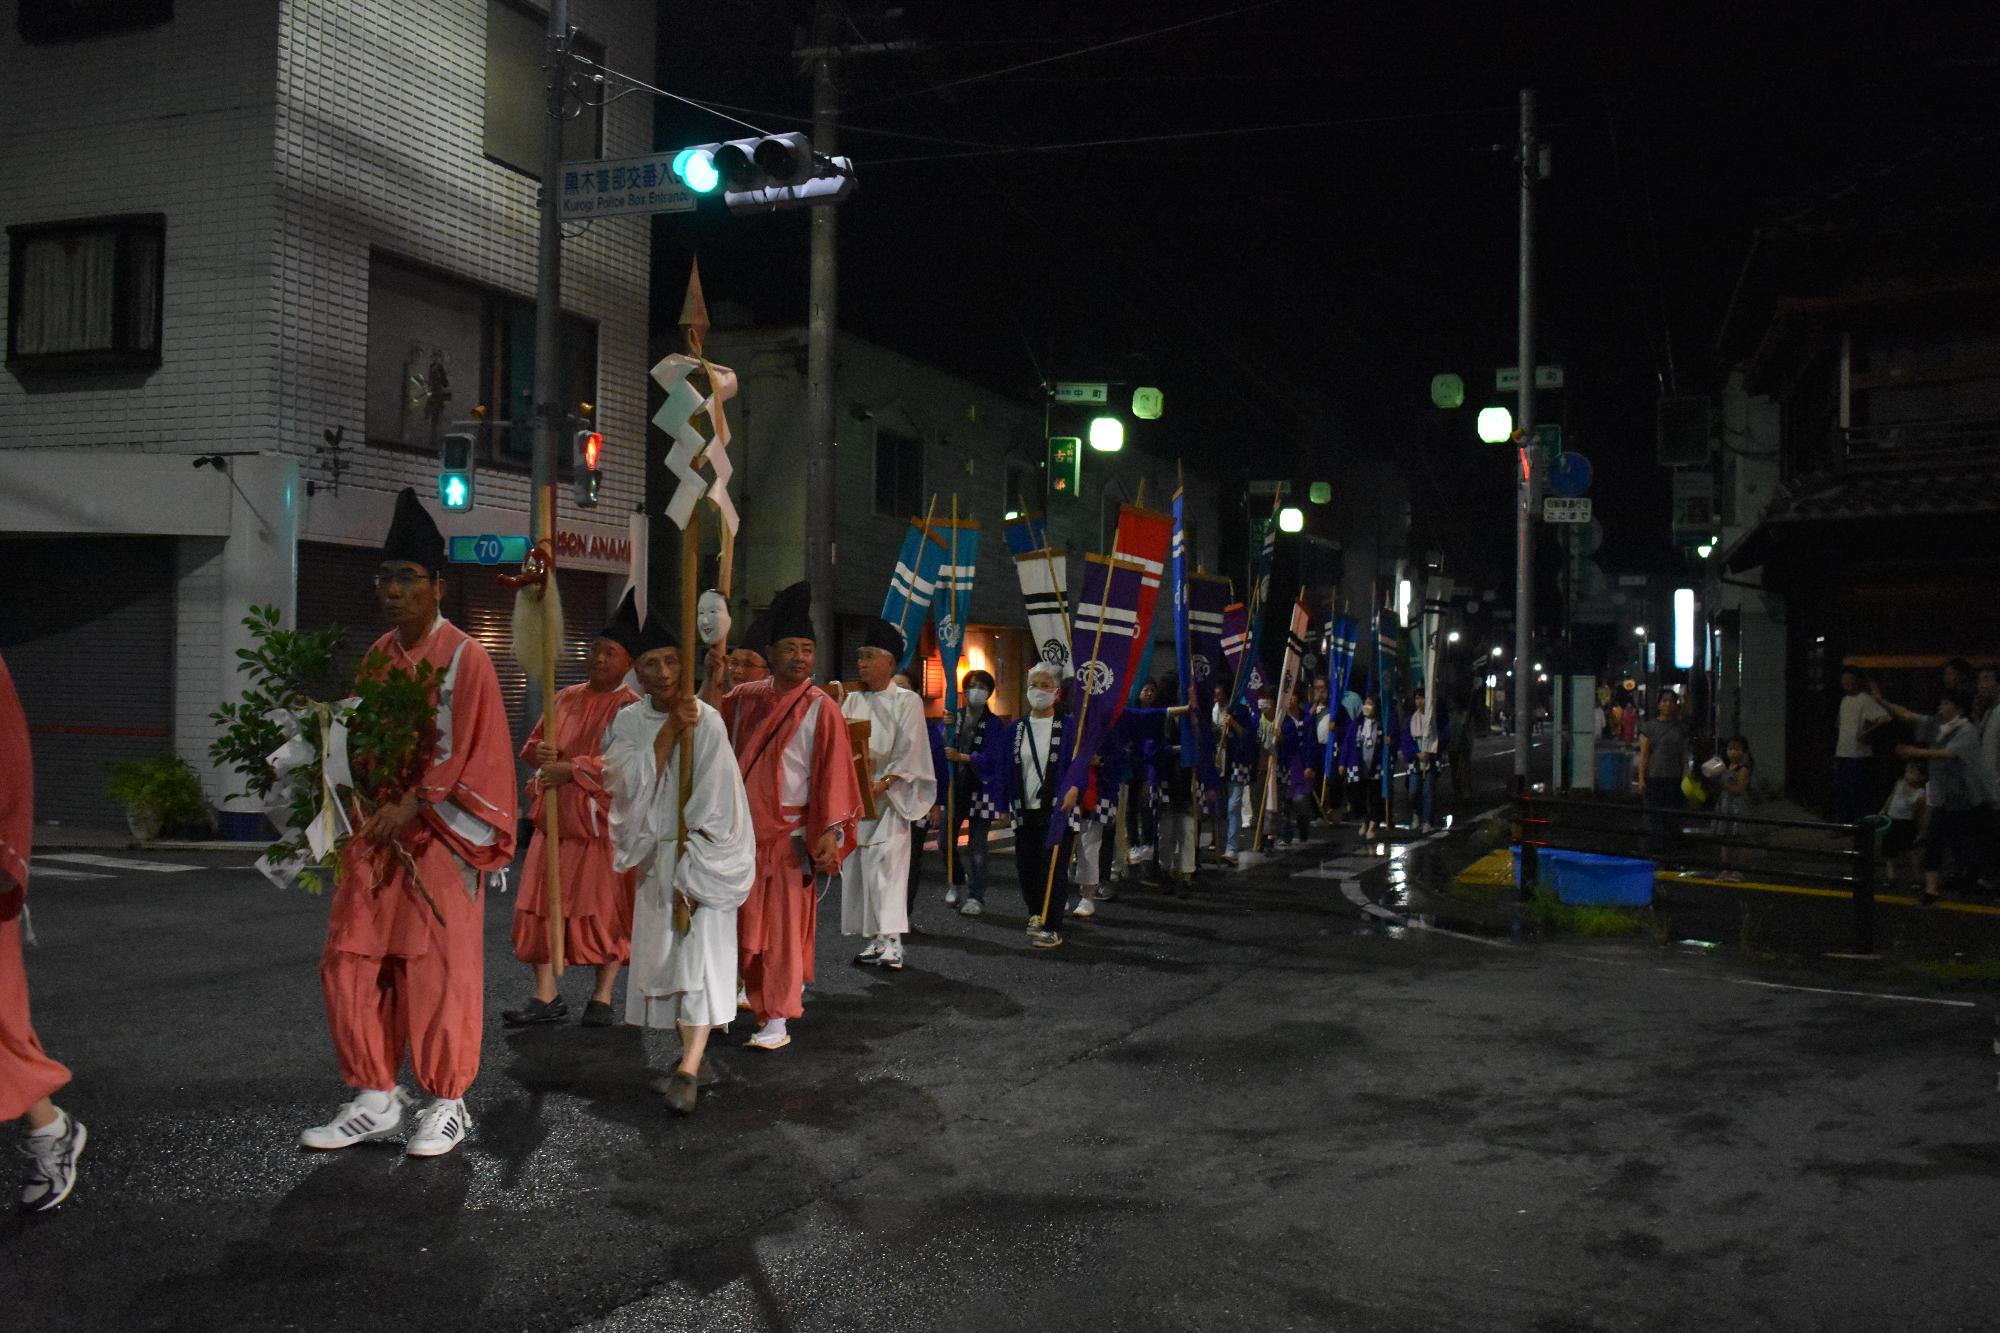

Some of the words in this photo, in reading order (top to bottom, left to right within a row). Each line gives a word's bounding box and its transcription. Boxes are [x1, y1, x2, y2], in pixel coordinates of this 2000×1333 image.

[563, 198, 593, 212] Kurogi
[597, 196, 625, 209] Police
[628, 193, 645, 206] Box
[649, 191, 688, 204] Entrance
[479, 540, 498, 559] 70
